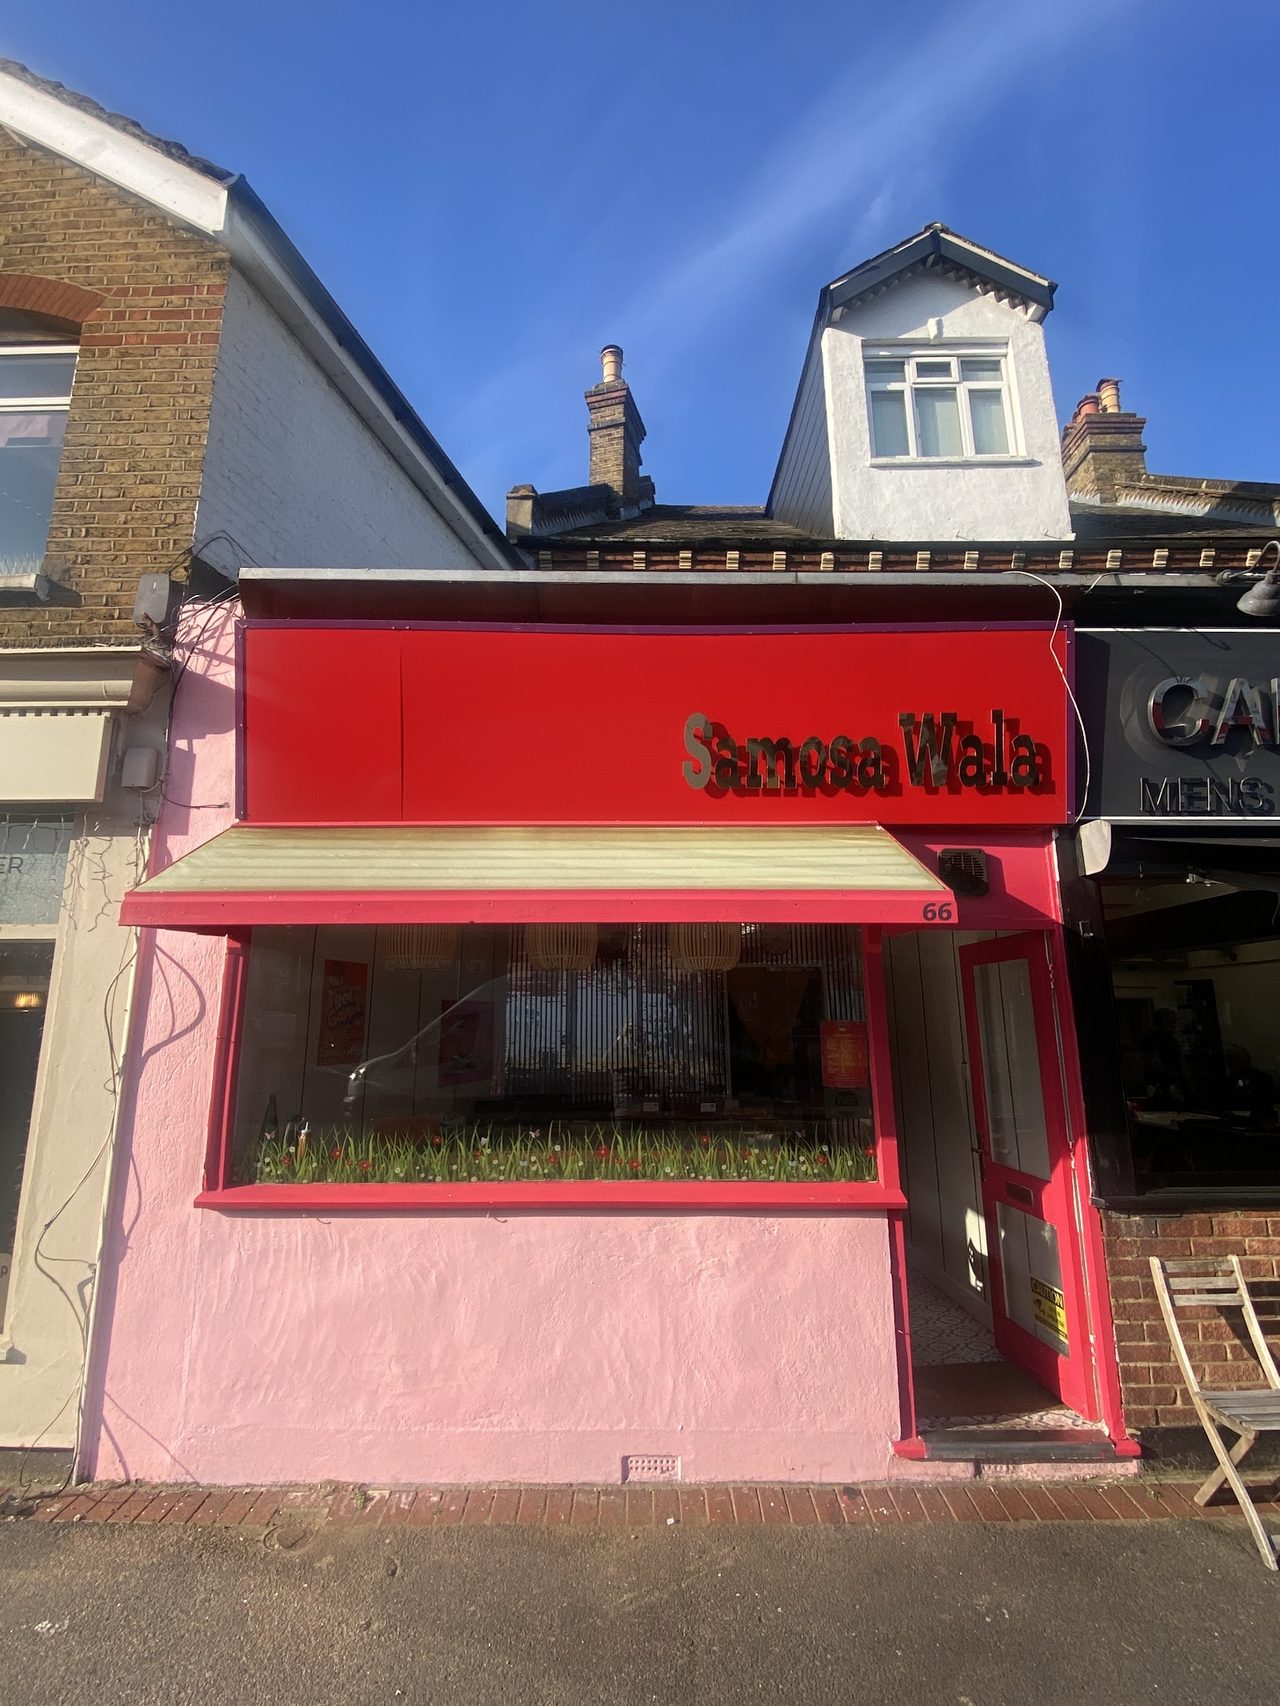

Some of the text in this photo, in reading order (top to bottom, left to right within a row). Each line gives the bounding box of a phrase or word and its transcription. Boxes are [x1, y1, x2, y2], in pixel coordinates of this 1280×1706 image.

[682, 709, 1042, 789] Samosa Wala
[1139, 776, 1264, 812] MENS
[922, 902, 953, 922] 66
[1031, 1280, 1064, 1309] CAUTION
